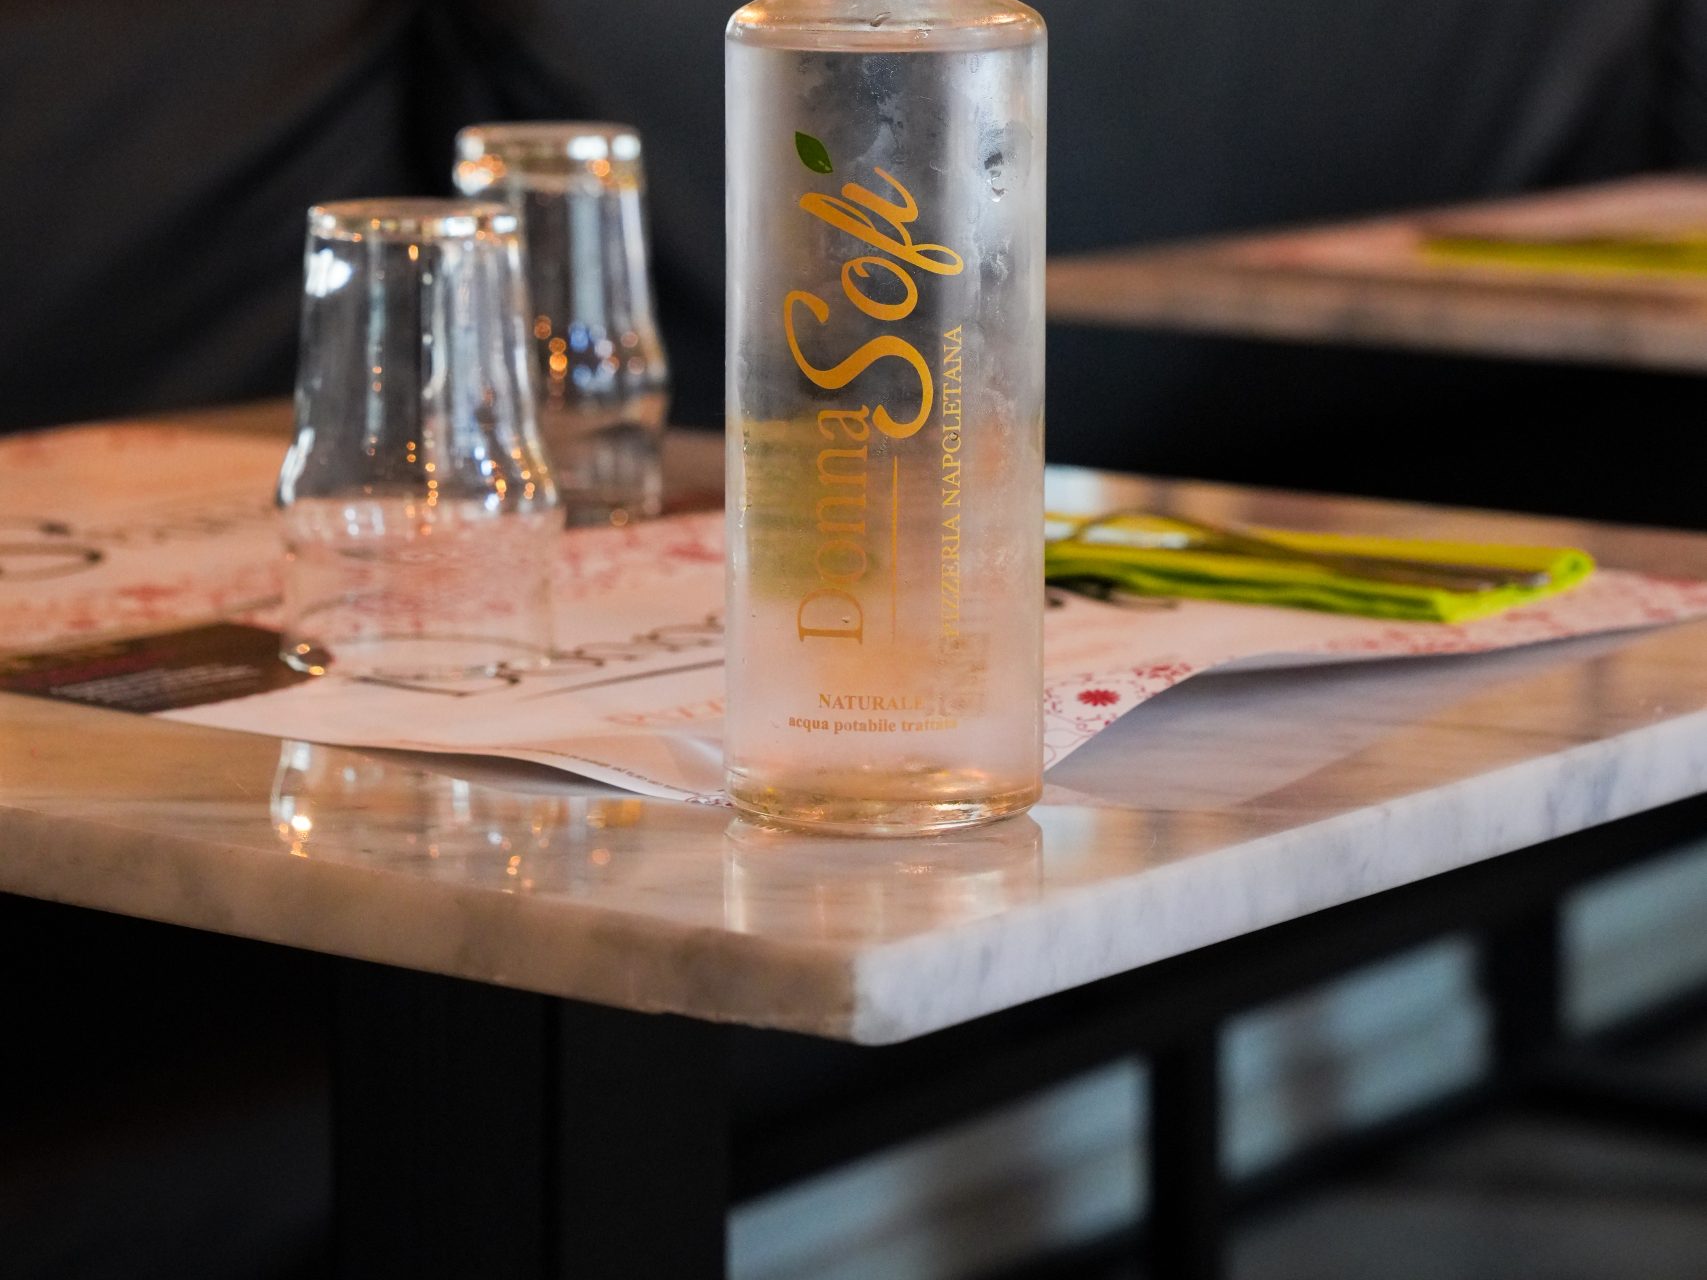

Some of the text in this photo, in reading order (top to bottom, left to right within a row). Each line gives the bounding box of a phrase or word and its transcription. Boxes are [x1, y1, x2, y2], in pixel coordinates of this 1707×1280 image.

[784, 166, 963, 645] Donna Sofi
[942, 324, 962, 639] PIZZERIA NAPOLETANA
[788, 716, 829, 733] acqua
[834, 719, 896, 734] potabile
